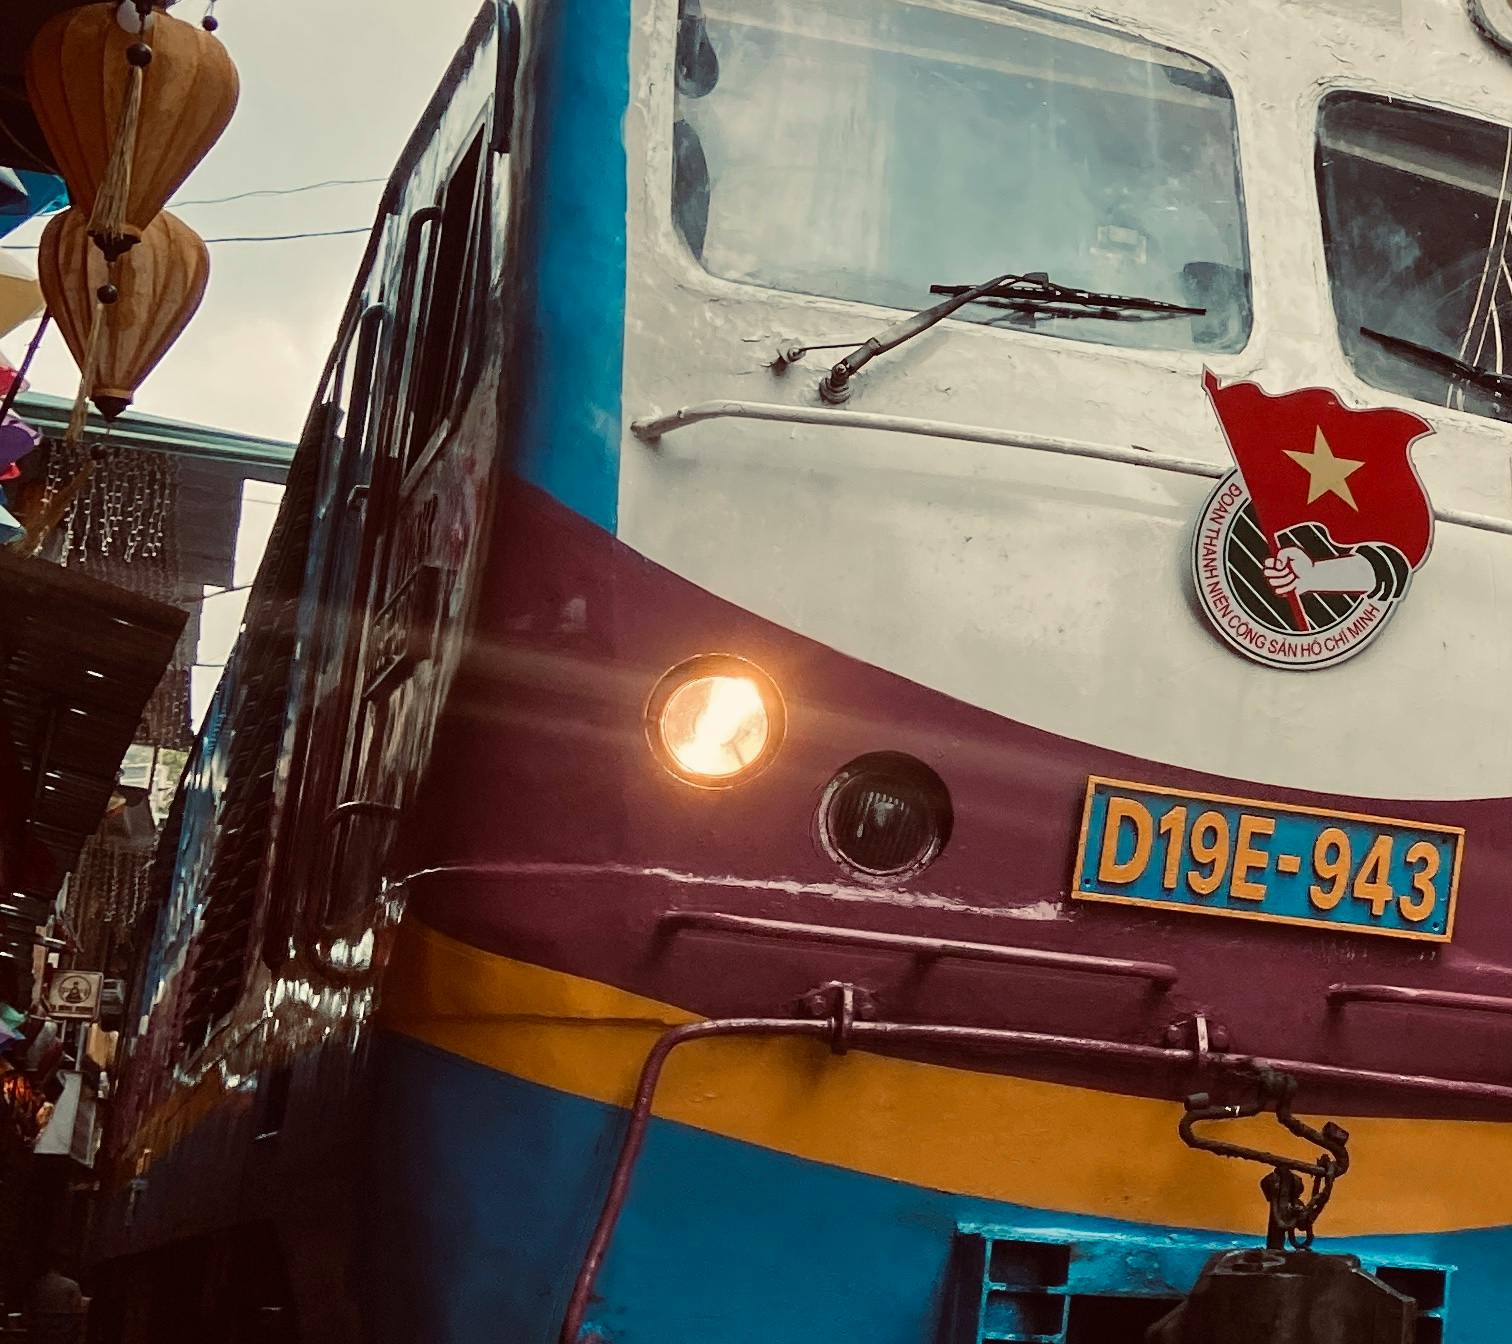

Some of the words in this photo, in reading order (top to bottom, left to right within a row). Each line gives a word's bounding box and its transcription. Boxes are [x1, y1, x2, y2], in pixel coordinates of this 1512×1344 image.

[1202, 527, 1221, 580] THANH
[1207, 582, 1232, 619] NIÊN
[1227, 615, 1267, 649] CỘNG
[1346, 603, 1381, 639] MINH
[1324, 628, 1350, 652] CHÍ
[1098, 795, 1440, 922] D19E-943
